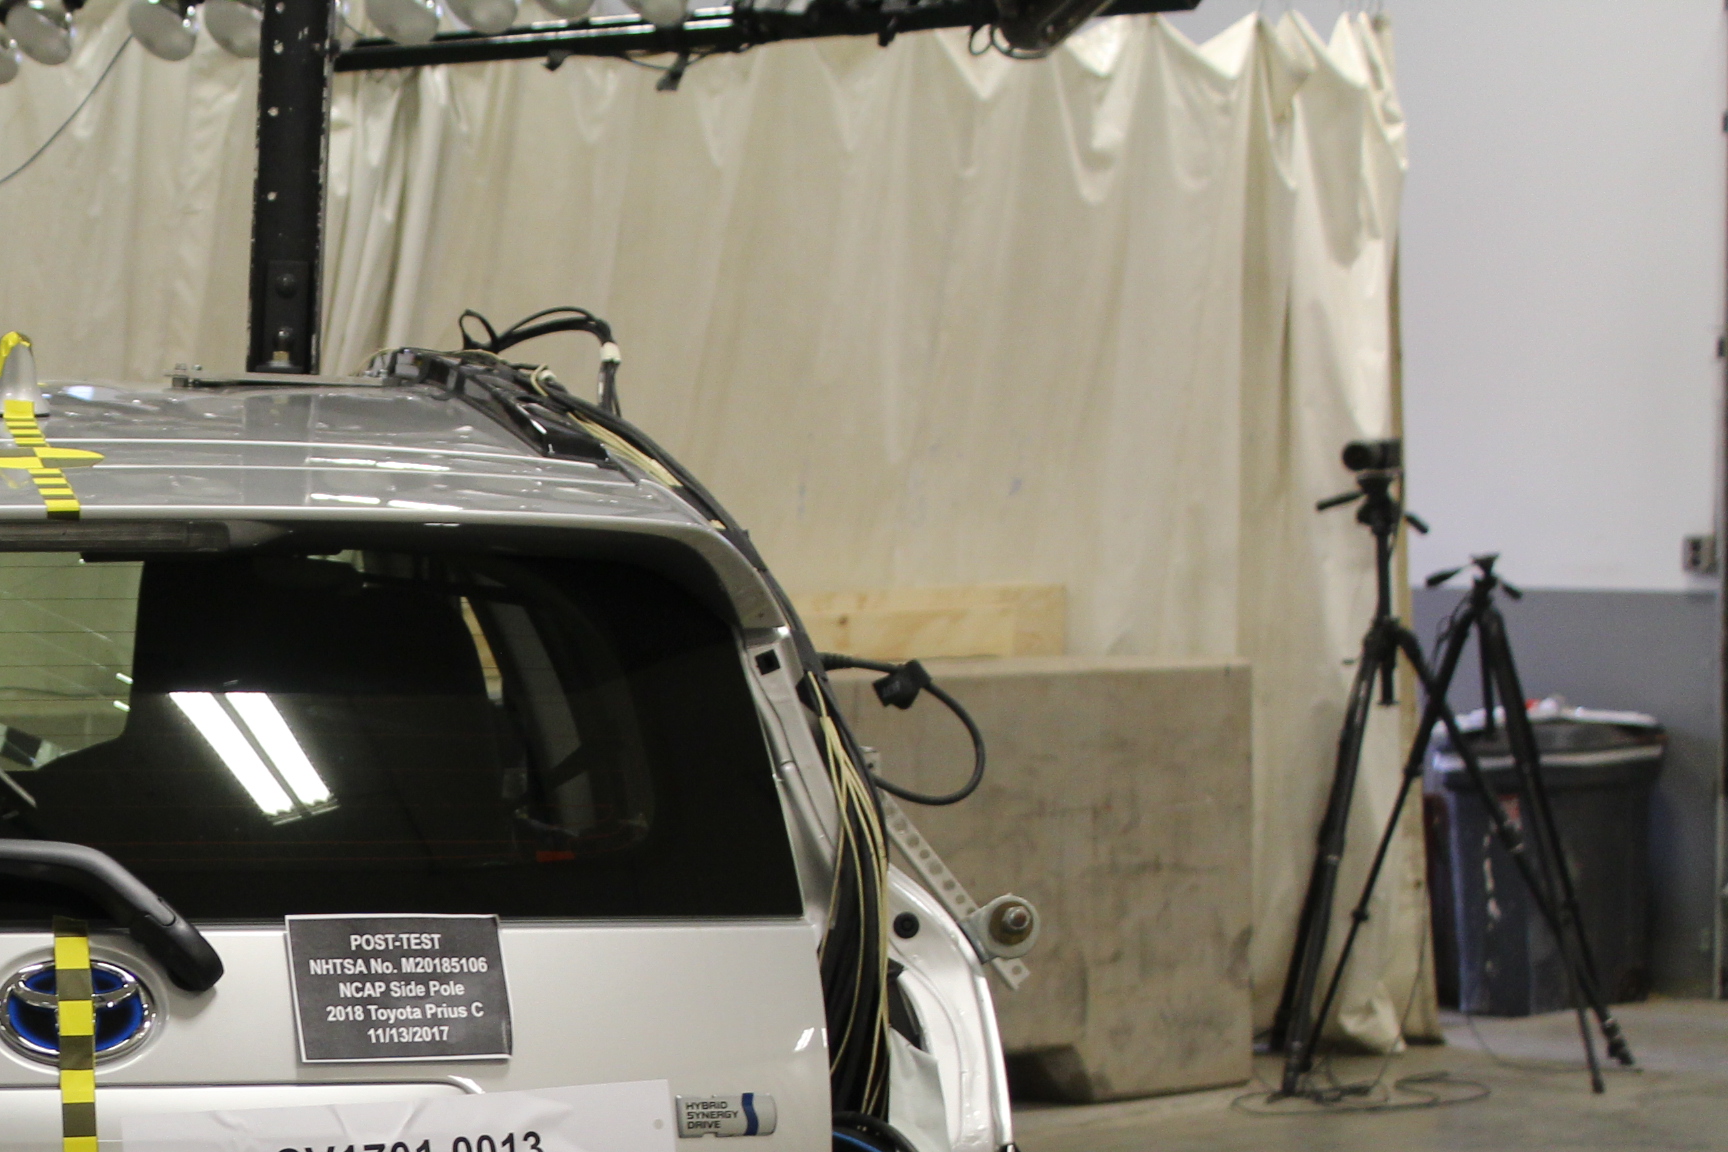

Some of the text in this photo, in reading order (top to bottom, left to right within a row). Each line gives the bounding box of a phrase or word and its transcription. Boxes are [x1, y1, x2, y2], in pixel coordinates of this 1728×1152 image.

[350, 933, 442, 950] POST-TEST
[309, 957, 488, 975] NHTSA No. M20185106
[338, 980, 465, 998] NCAP Side Pole
[325, 1002, 484, 1024] 2018 Toyota Prius C
[367, 1026, 450, 1043] 11/13/2017
[686, 1101, 727, 1109] HYBRID
[687, 1110, 738, 1119] SYNERGY
[688, 1120, 721, 1129] DRIVE
